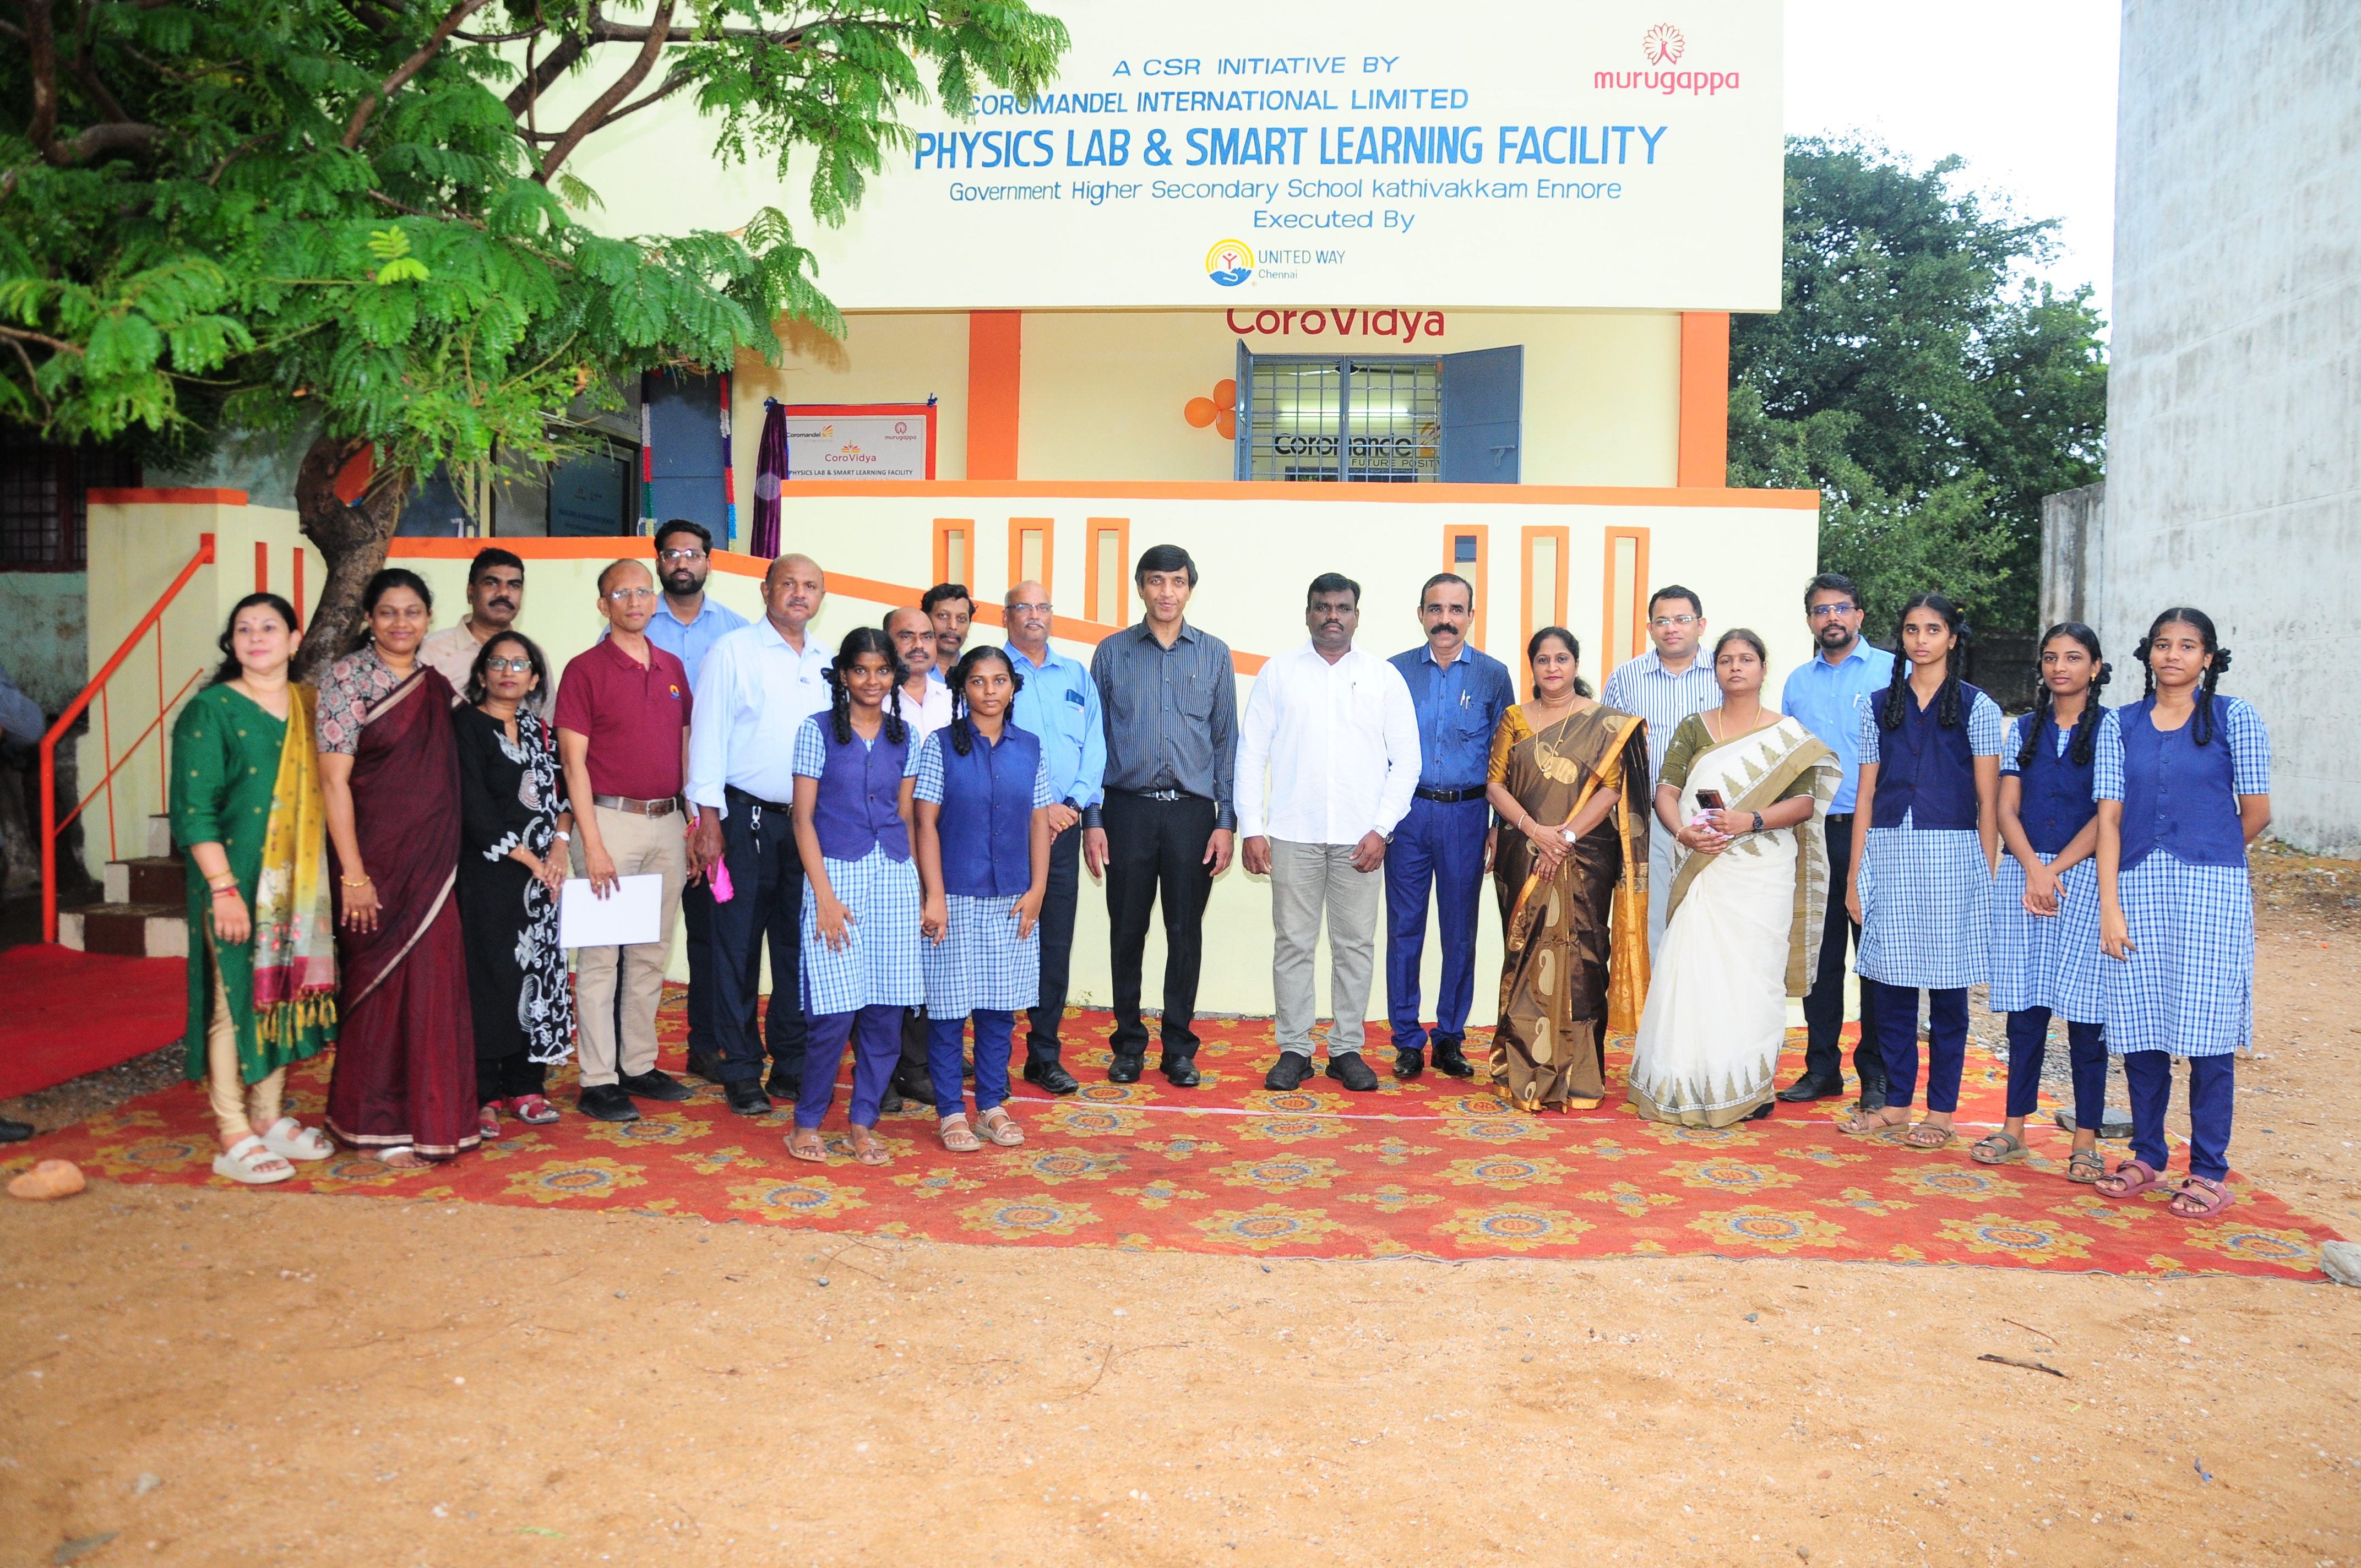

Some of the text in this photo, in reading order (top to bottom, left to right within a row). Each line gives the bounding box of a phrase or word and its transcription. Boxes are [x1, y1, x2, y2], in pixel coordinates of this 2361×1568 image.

[1112, 56, 1400, 76] A CSR INITIATIVE BY
[1594, 71, 1739, 96] murugappa
[1137, 90, 1339, 112] INTERNATIONAL
[1351, 88, 1469, 110] LIMITED
[915, 126, 1668, 170] PHYSICS LAB & SMART LEARNING FACILITY
[950, 182, 1062, 201] Government
[1073, 181, 1143, 206] Higher
[1152, 180, 1279, 204] Secondary
[1288, 178, 1363, 198] School
[1537, 178, 1622, 199] Ennore
[1254, 210, 1415, 233] Executed By
[1259, 250, 1346, 264] UNITED WAY
[1258, 269, 1298, 279] Chennai
[825, 454, 877, 463] CoroVidya
